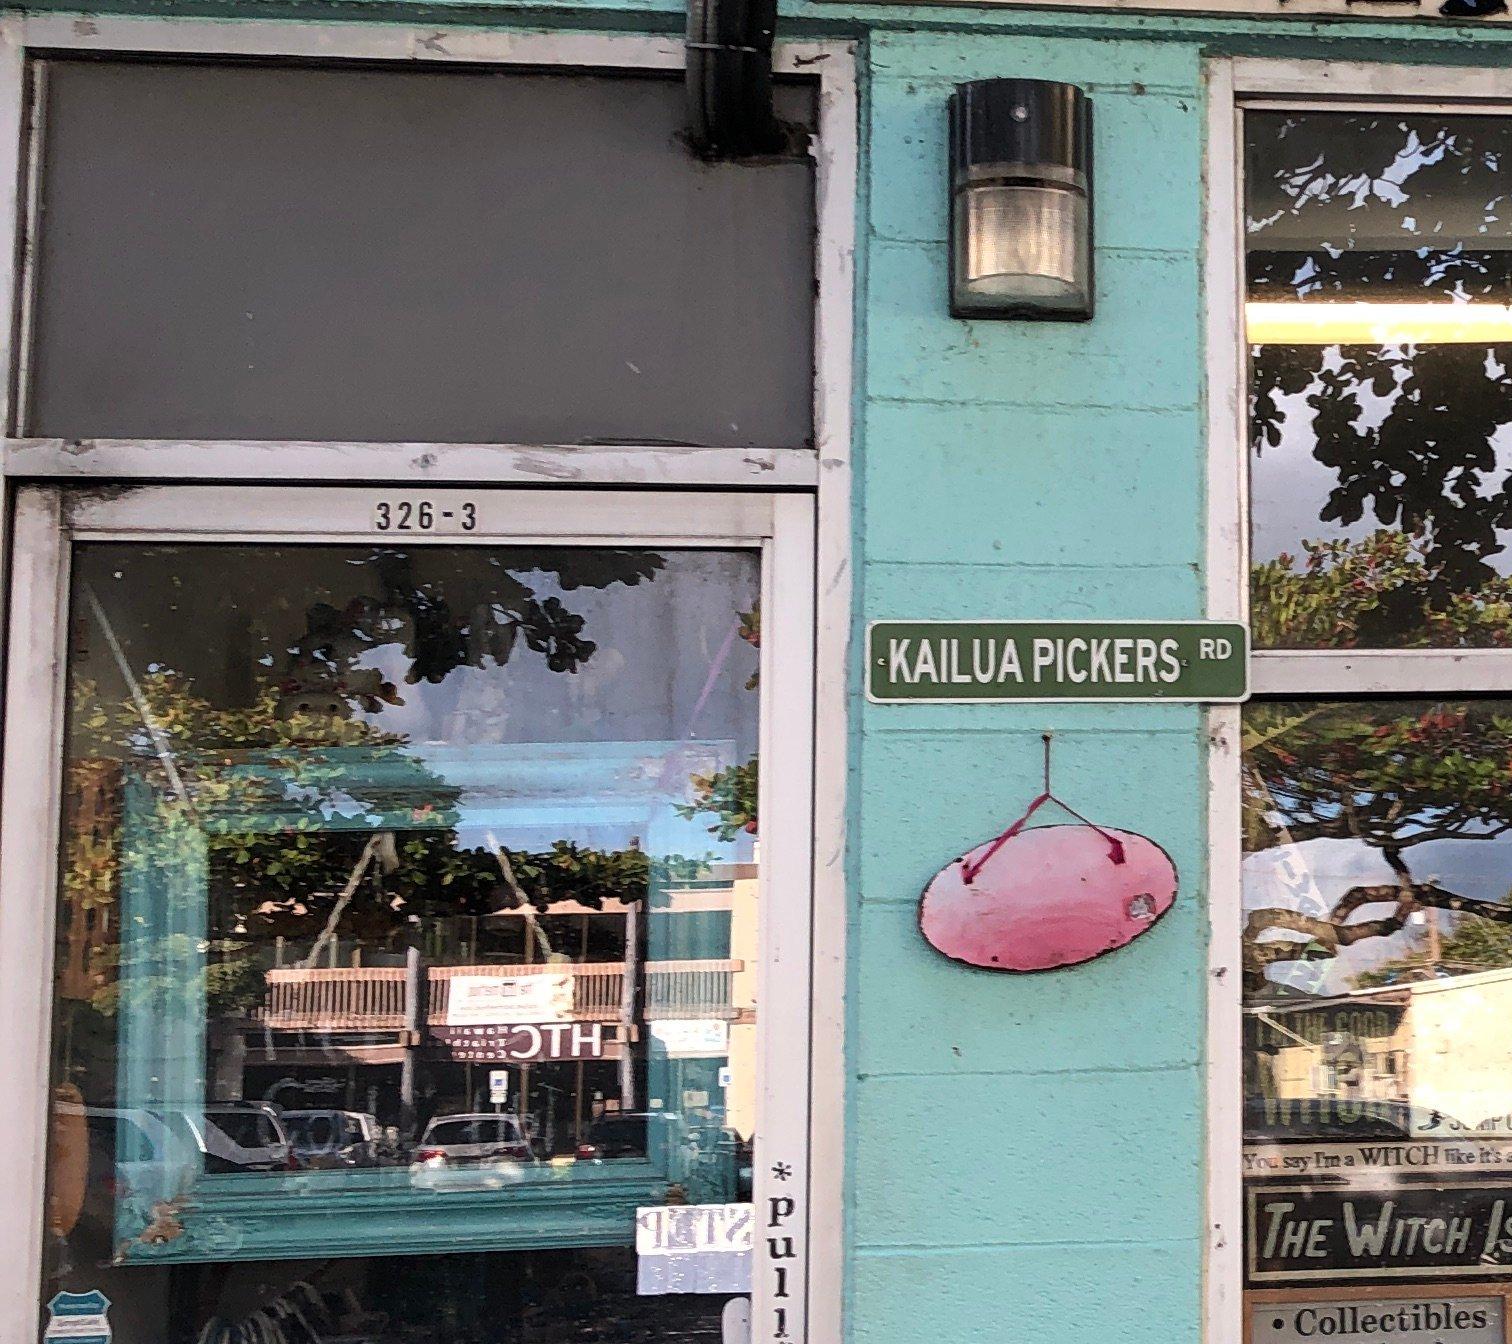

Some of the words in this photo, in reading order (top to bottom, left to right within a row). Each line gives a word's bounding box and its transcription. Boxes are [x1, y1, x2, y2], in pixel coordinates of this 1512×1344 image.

[376, 501, 477, 531] 326-3
[889, 638, 1024, 684] KAILUA
[1033, 638, 1182, 684] PICKERS
[1200, 638, 1232, 661] RD
[1359, 1145, 1440, 1167] WITCH
[1294, 1303, 1488, 1336] Collectibles
